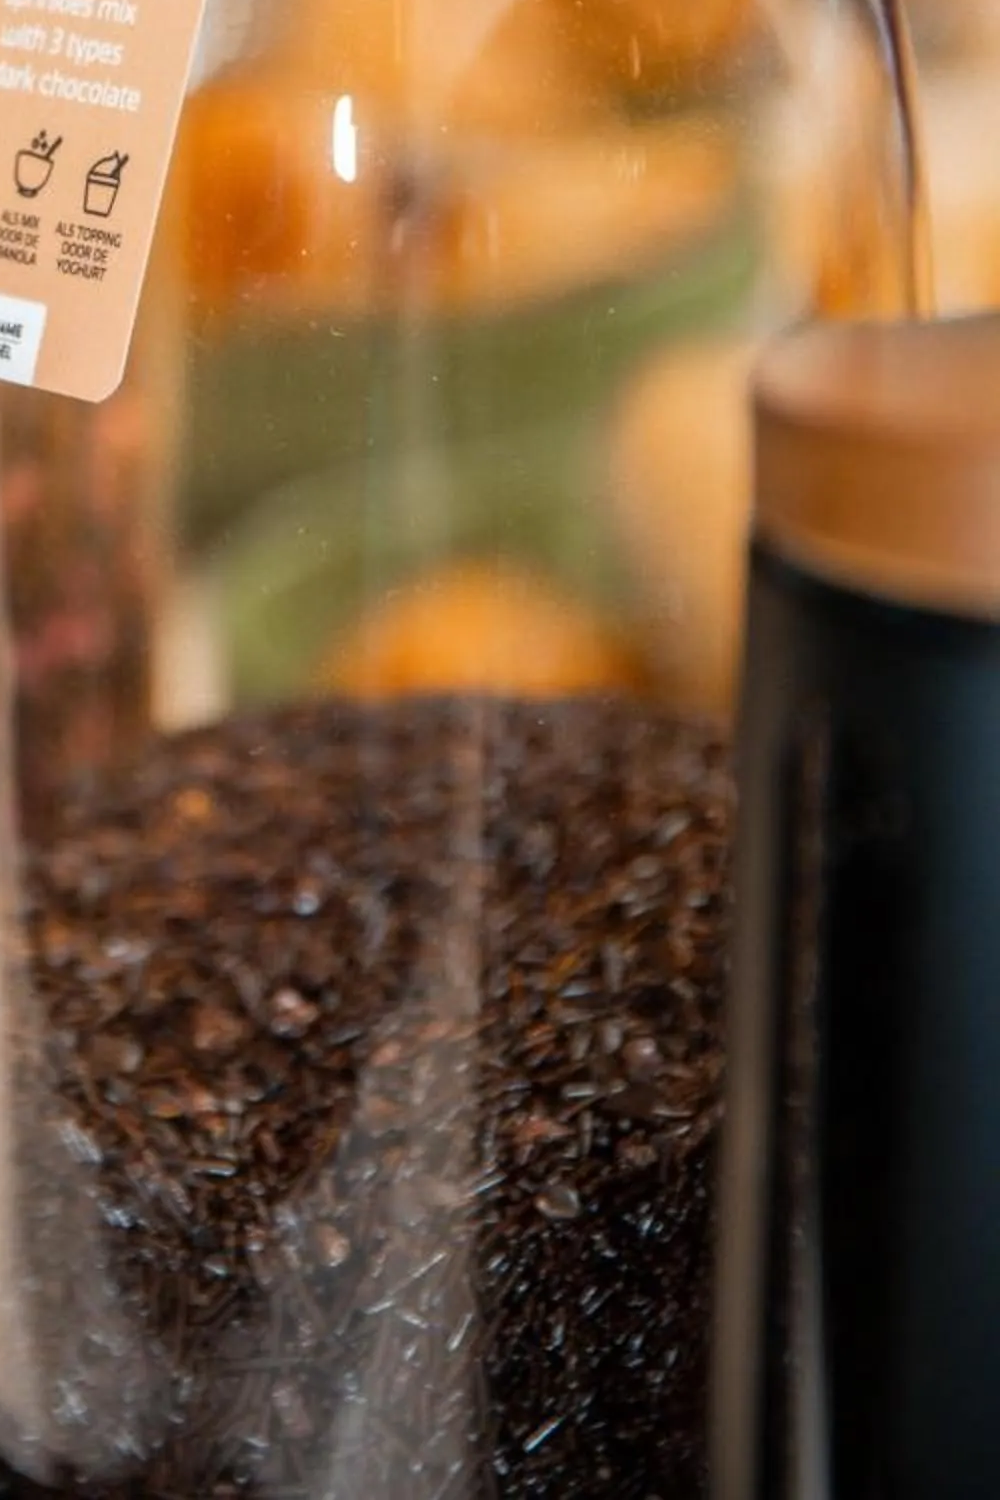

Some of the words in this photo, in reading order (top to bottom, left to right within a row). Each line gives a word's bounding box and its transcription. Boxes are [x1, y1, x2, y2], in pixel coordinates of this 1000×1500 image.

[0, 23, 46, 53] with
[49, 27, 64, 56] 3
[66, 33, 124, 66] types
[38, 70, 141, 112] chocolate
[56, 221, 75, 238] ALS
[77, 225, 122, 248] TOPPING
[61, 241, 91, 260] DOOR
[93, 248, 109, 263] DE
[57, 259, 107, 281] YOGHURT
